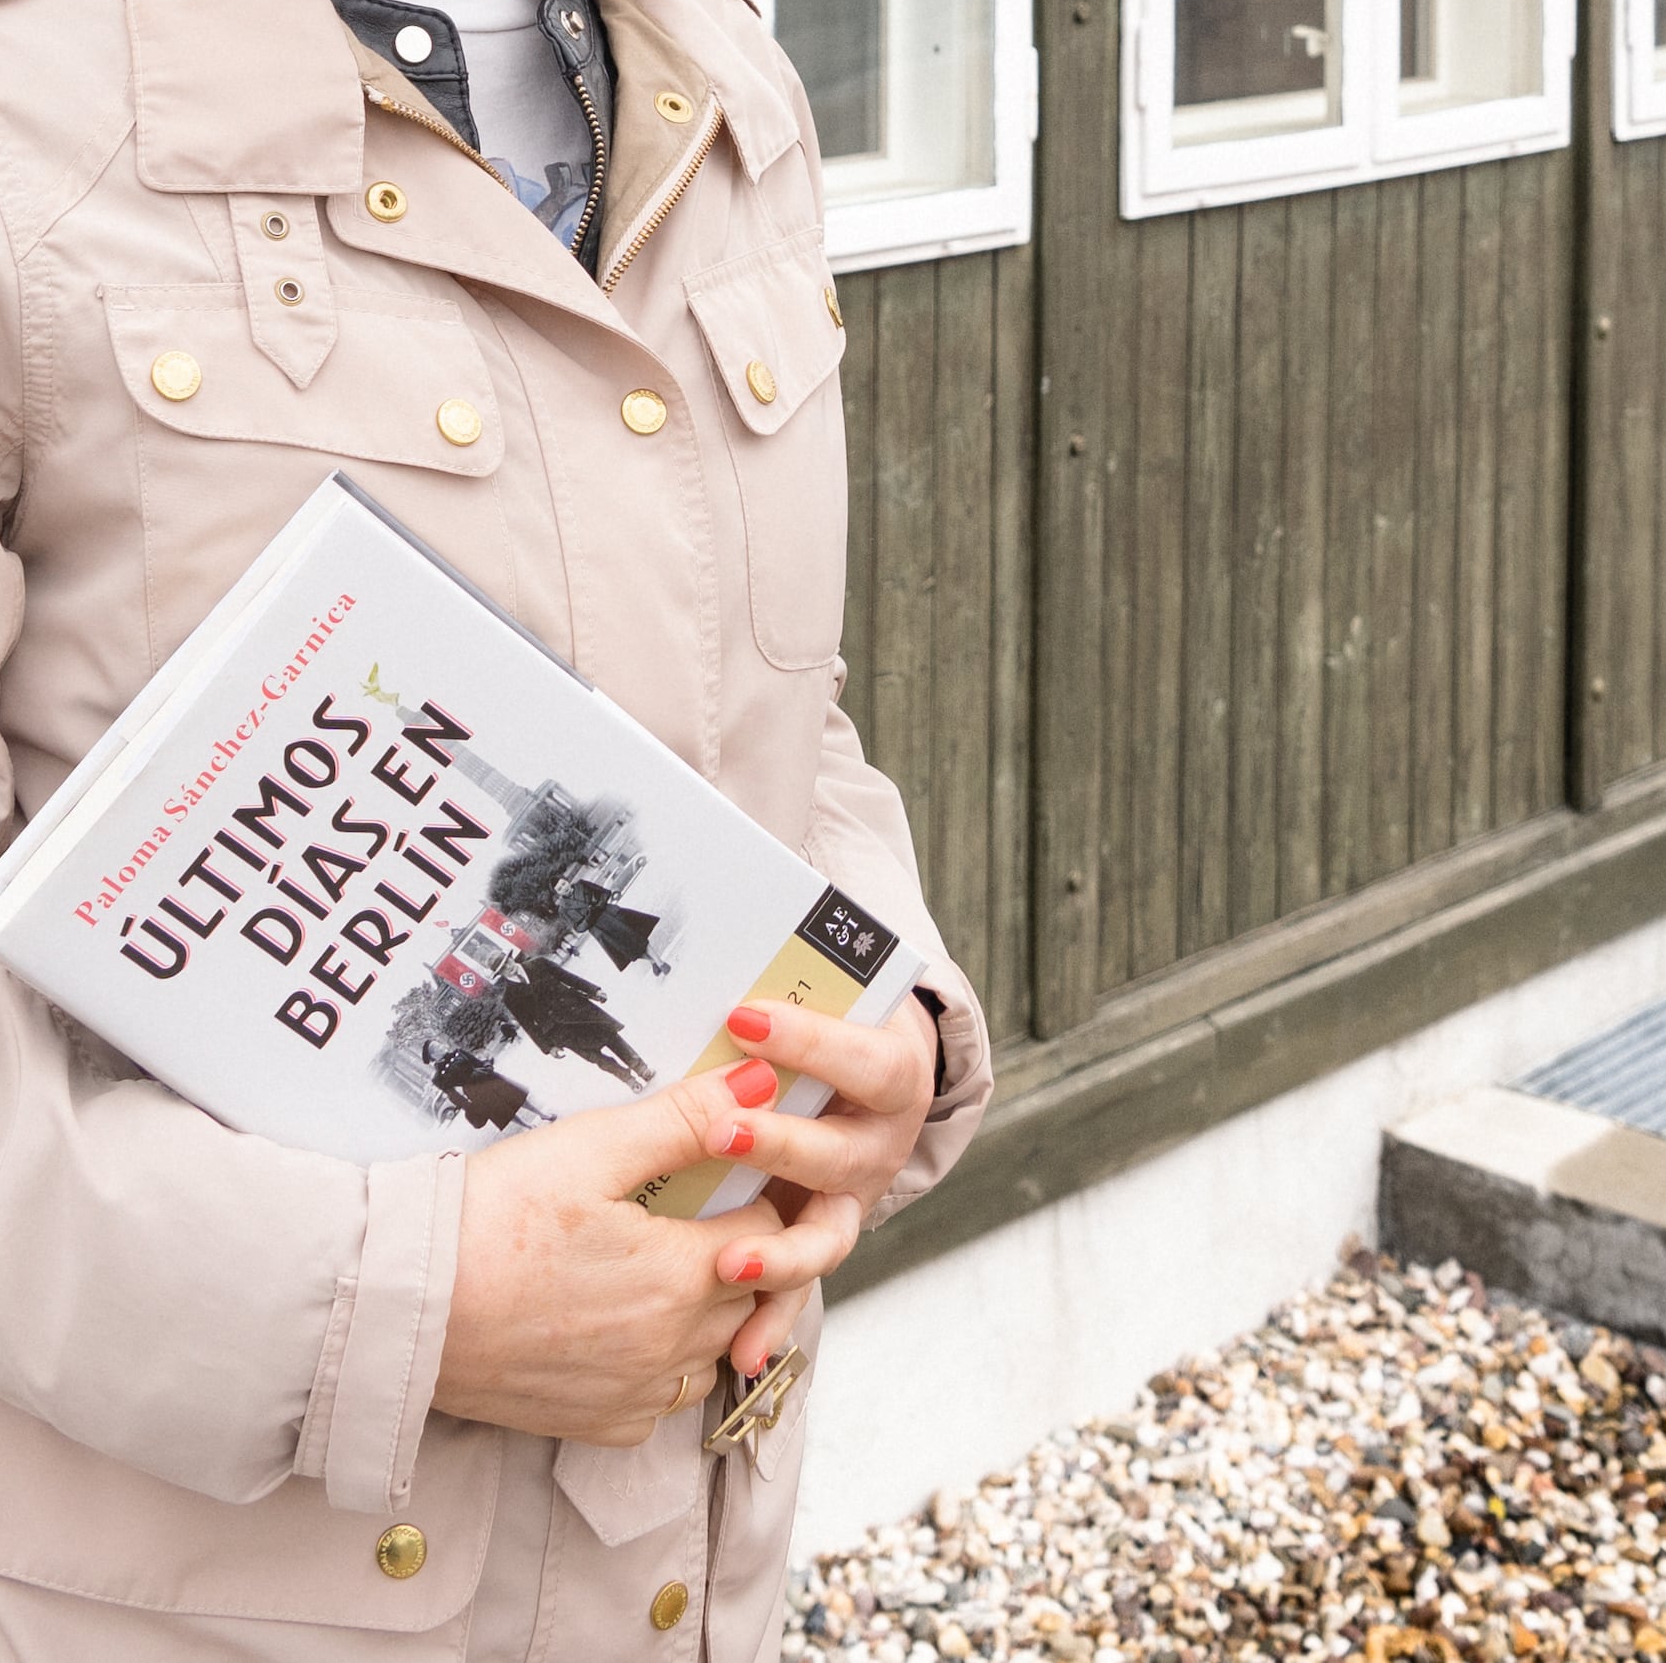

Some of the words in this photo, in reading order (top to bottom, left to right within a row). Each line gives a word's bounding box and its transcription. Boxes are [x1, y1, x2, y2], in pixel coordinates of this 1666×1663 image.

[73, 825, 172, 928] Paloma
[163, 593, 358, 823] Sánchez-Garnica
[120, 692, 372, 980] ÚLTIMOS
[239, 796, 391, 966] DÍAS
[370, 699, 474, 806] EN
[274, 798, 492, 1049] BERLÍN
[635, 1172, 672, 1209] PRE
[787, 979, 812, 1006] 21
